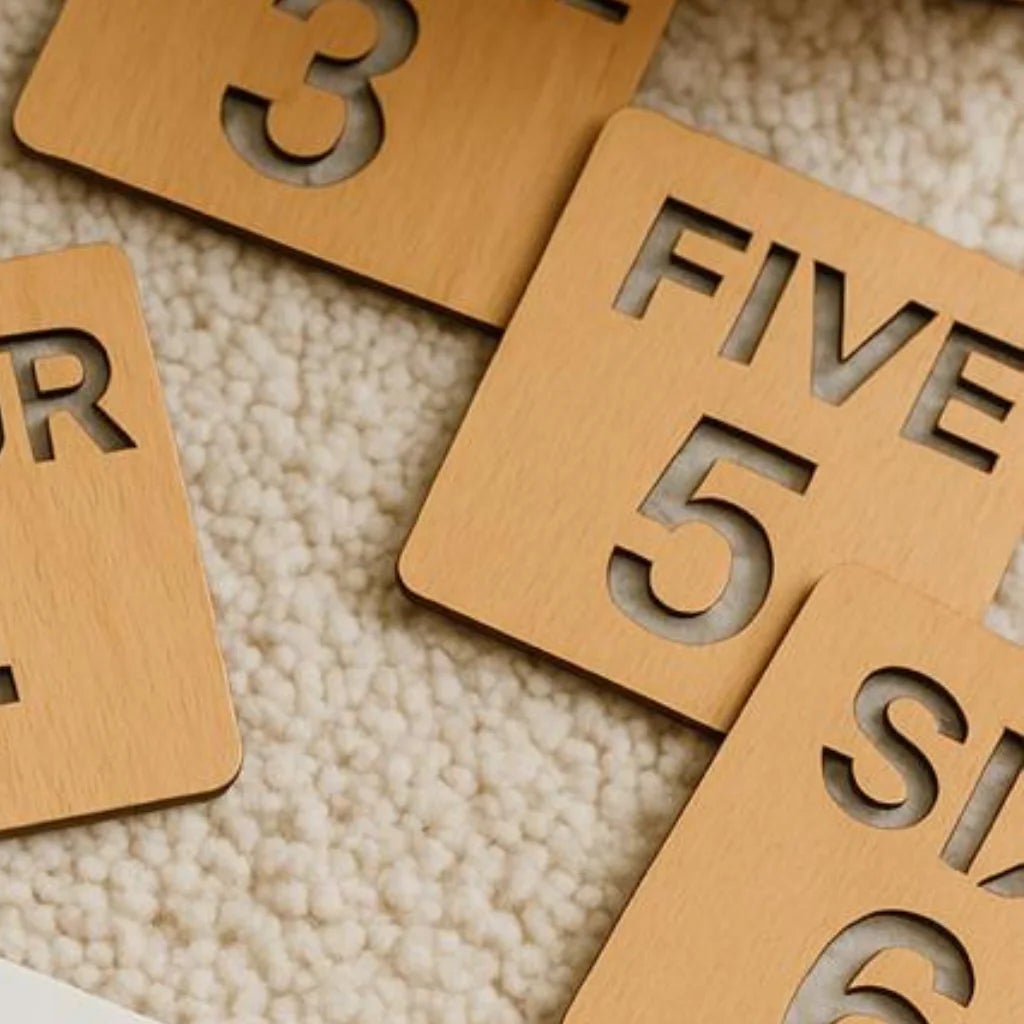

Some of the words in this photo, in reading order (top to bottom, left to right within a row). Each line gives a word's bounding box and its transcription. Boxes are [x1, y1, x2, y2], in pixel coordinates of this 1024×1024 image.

[220, 0, 419, 188] 3
[612, 195, 1024, 474] FIVE
[606, 414, 818, 646] 5
[821, 666, 1024, 898] SI
